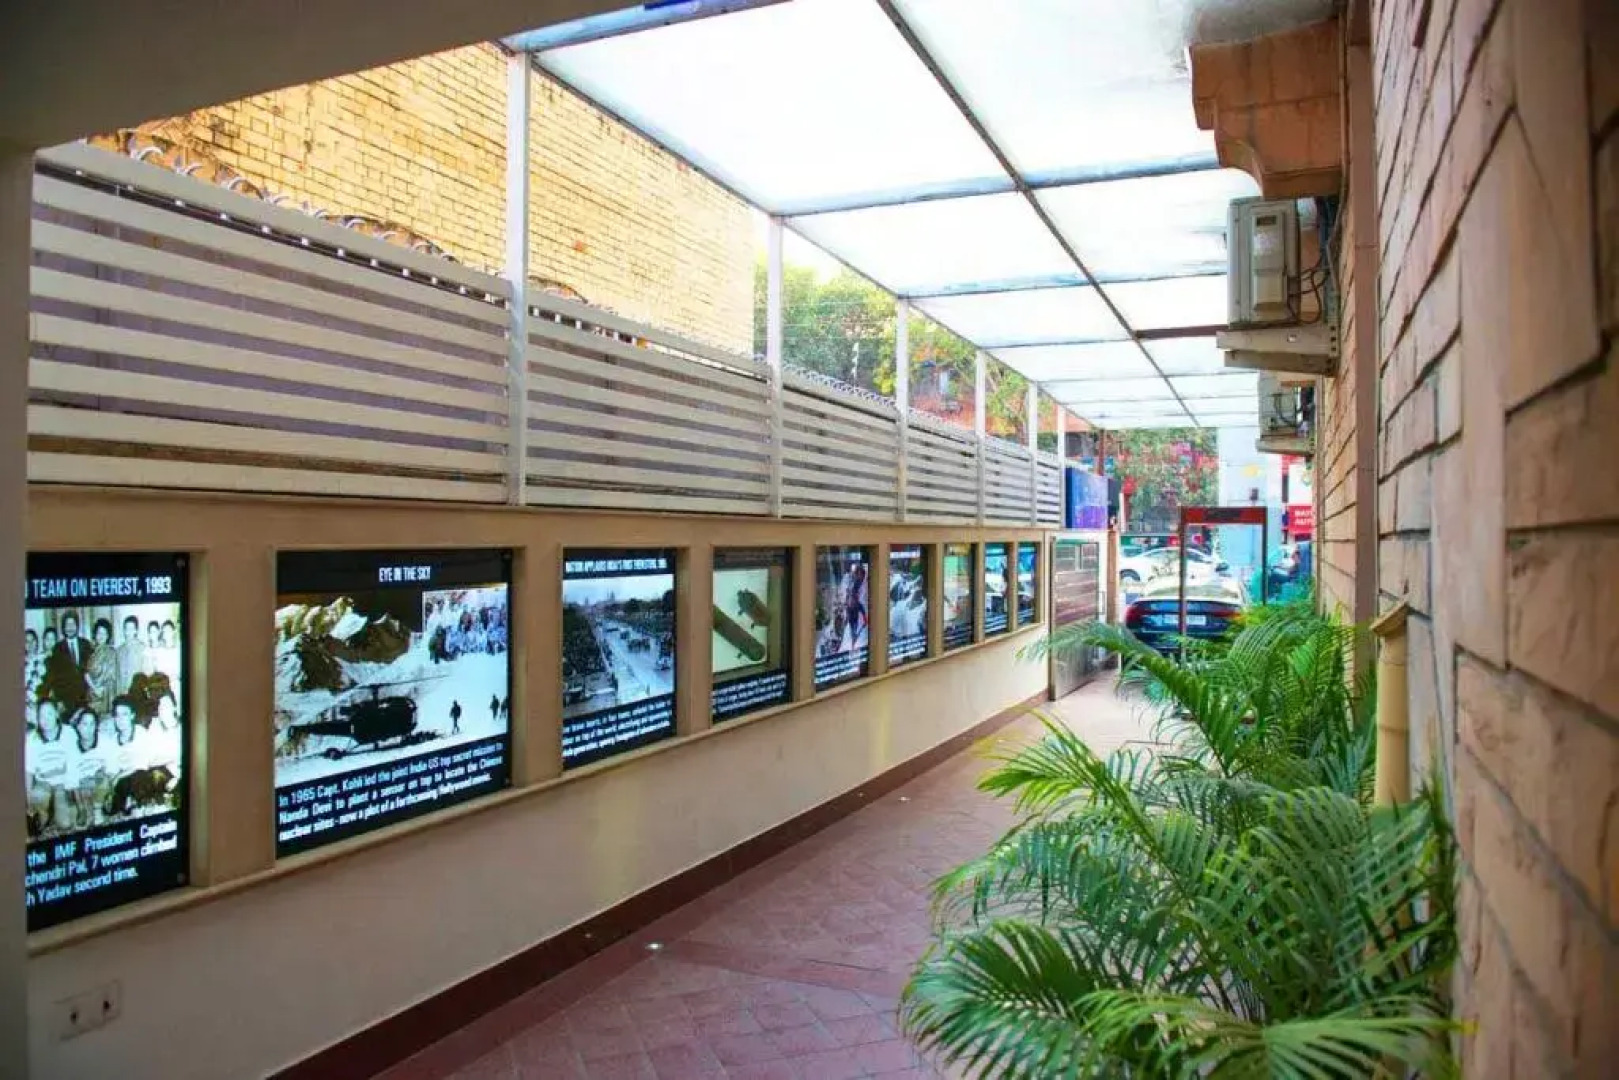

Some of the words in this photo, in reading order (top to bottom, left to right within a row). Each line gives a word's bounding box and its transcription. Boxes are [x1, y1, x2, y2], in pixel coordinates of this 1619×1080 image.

[379, 567, 393, 582] EYE
[32, 579, 67, 598] TEAM
[70, 578, 88, 597] ON
[90, 576, 142, 597] EVEREST,
[145, 576, 172, 594] 1993
[291, 787, 316, 804] 1965
[27, 852, 47, 867] the
[54, 841, 77, 860] IMF
[84, 830, 134, 852] President
[91, 854, 99, 870] 7
[101, 848, 139, 867] women
[37, 884, 72, 903] Yadav
[74, 870, 112, 893] second
